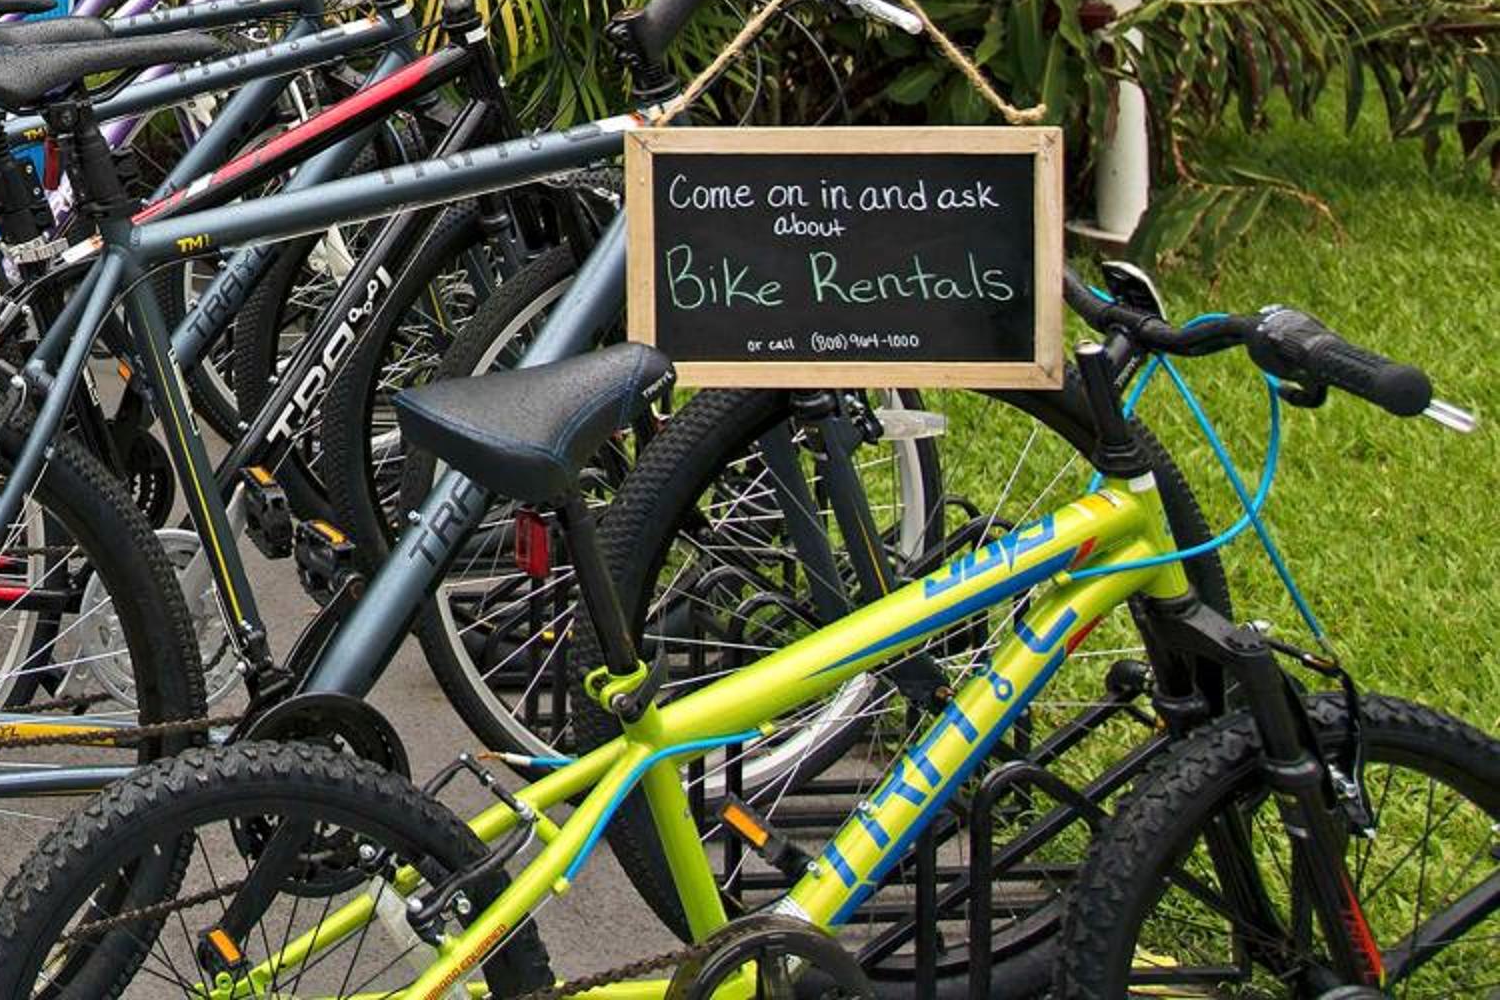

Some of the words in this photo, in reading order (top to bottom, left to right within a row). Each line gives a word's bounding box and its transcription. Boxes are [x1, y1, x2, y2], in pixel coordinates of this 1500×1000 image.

[669, 174, 755, 211] Come
[767, 184, 809, 209] on
[820, 179, 852, 210] in
[860, 180, 927, 212] and
[937, 181, 1000, 209] ask
[773, 217, 847, 237] about
[666, 244, 784, 309] Bike
[809, 250, 1015, 304] Rentals
[747, 340, 762, 351] or
[768, 336, 795, 351] call
